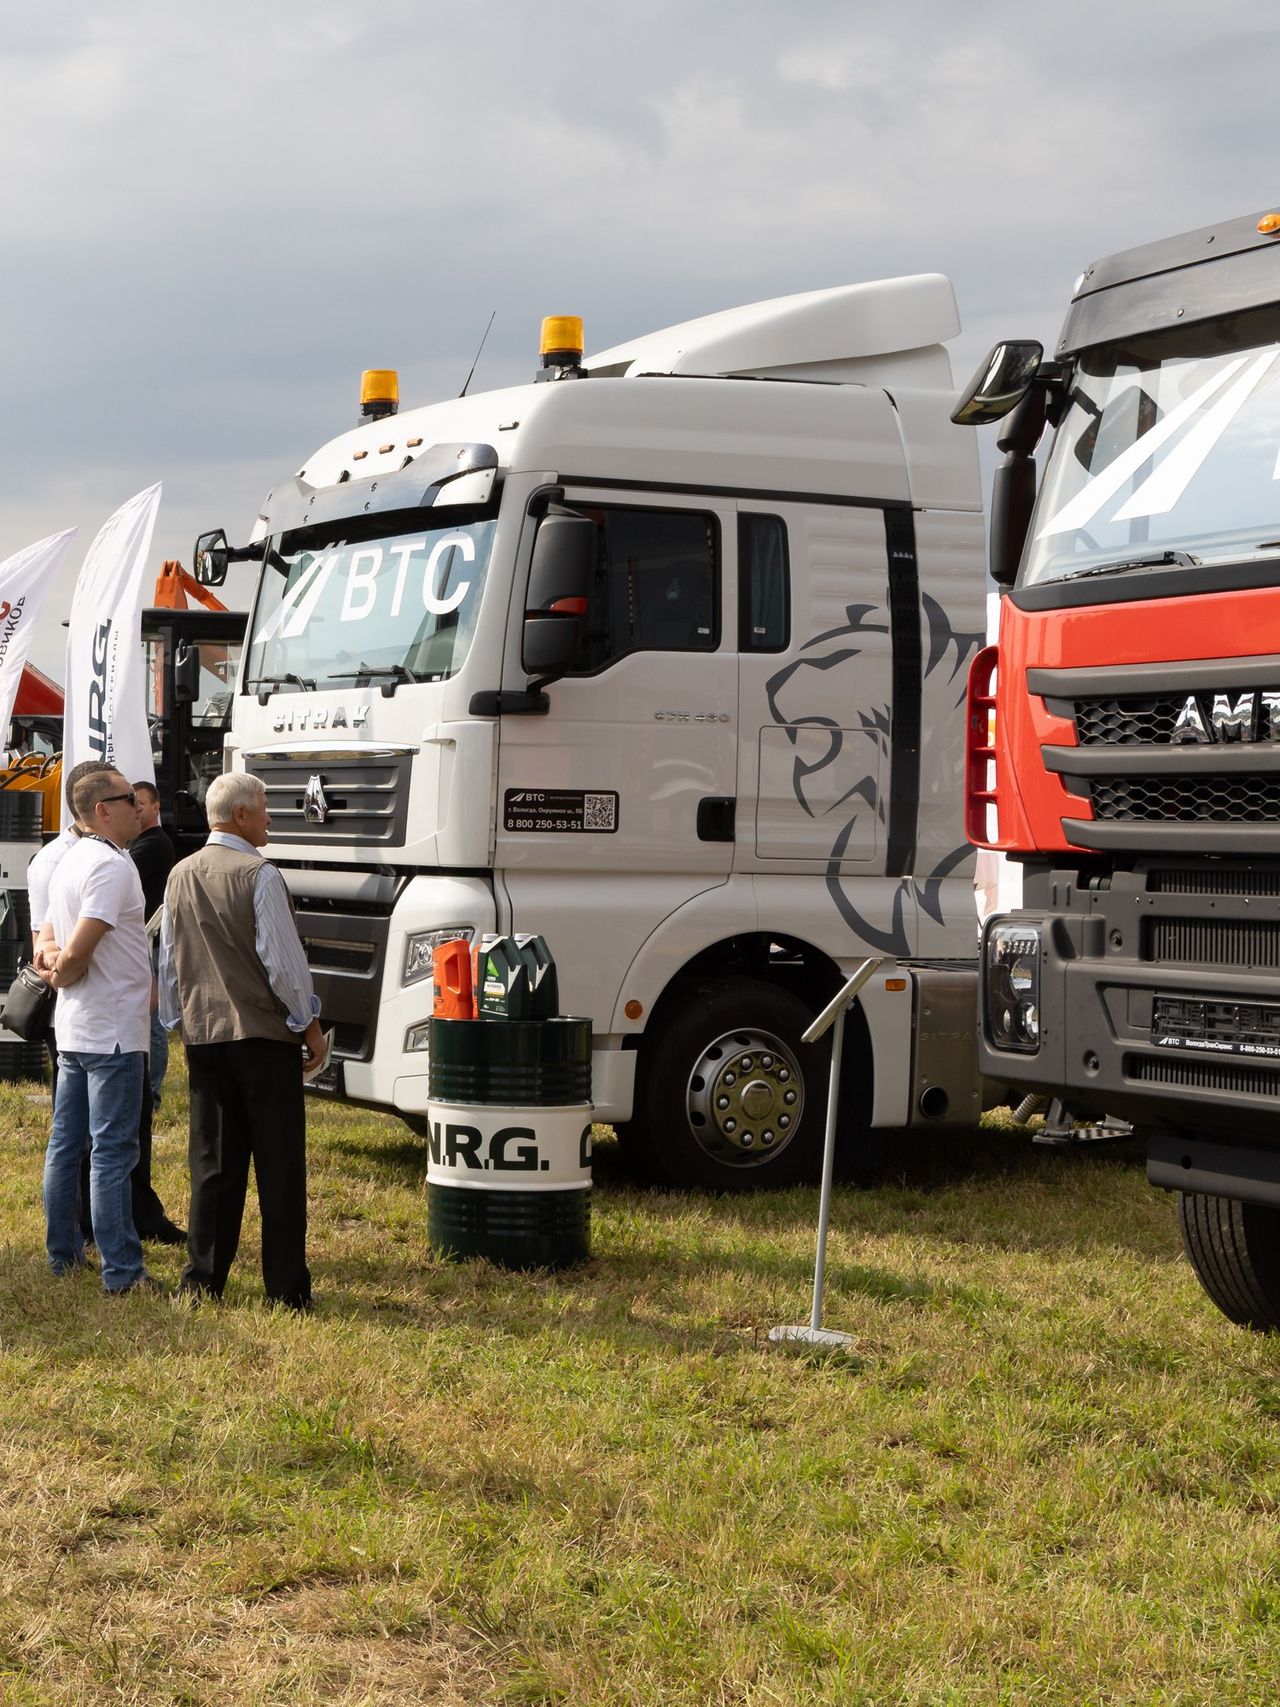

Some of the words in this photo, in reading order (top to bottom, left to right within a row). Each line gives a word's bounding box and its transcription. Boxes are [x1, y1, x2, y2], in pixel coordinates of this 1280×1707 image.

[340, 531, 475, 622] ВТС
[273, 705, 371, 733] SITRAK
[526, 793, 545, 802] ВТС
[507, 819, 514, 828] 8
[516, 820, 534, 828] 800
[535, 820, 582, 829] 250-53-51
[920, 1032, 973, 1042] SITRA
